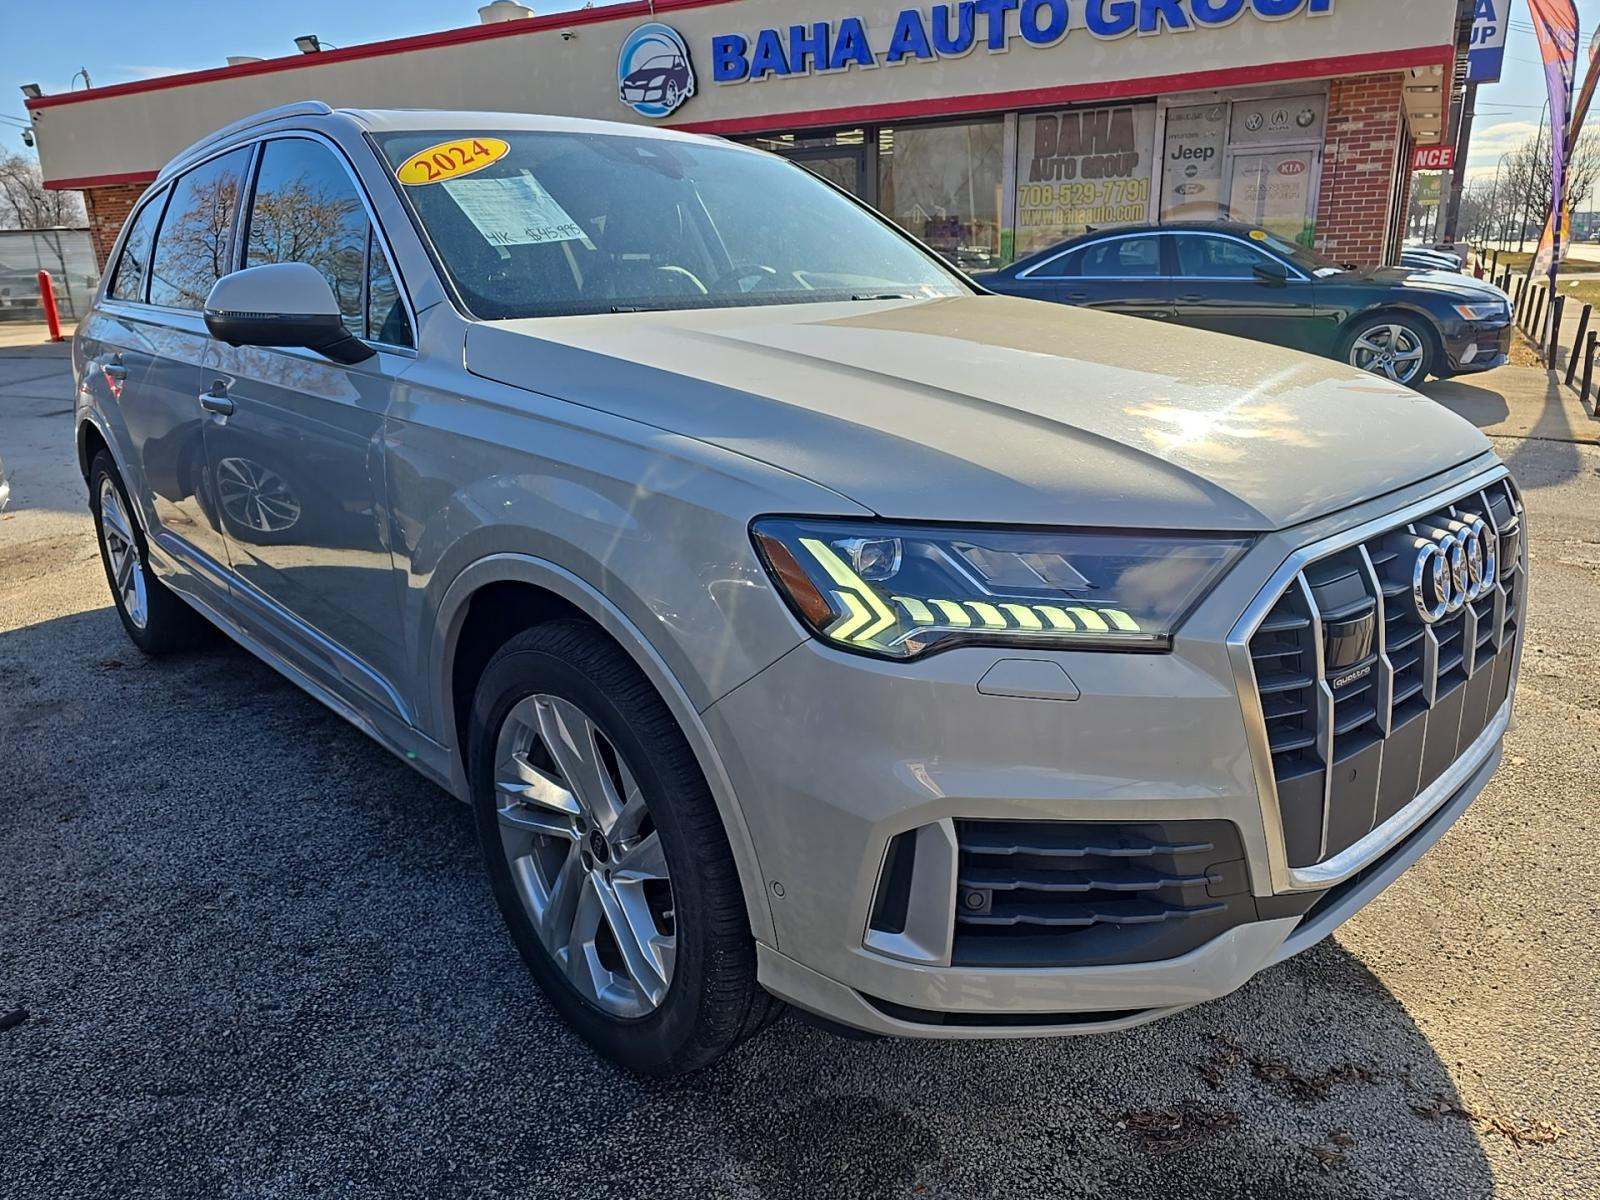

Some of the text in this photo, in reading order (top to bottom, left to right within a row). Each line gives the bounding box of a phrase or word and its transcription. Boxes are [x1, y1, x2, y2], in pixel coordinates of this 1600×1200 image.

[712, 0, 1332, 83] BAHA AUTO GRO
[1470, 25, 1497, 45] UP
[1034, 107, 1136, 159] BAHA
[414, 139, 491, 181] 2024
[1171, 144, 1215, 161] Jeep
[1414, 149, 1452, 167] NCE
[1029, 152, 1139, 183] AUTO GROUP
[1281, 163, 1301, 174] KIA
[1018, 177, 1149, 208] 708-529-7791
[1336, 666, 1371, 687] quattro
